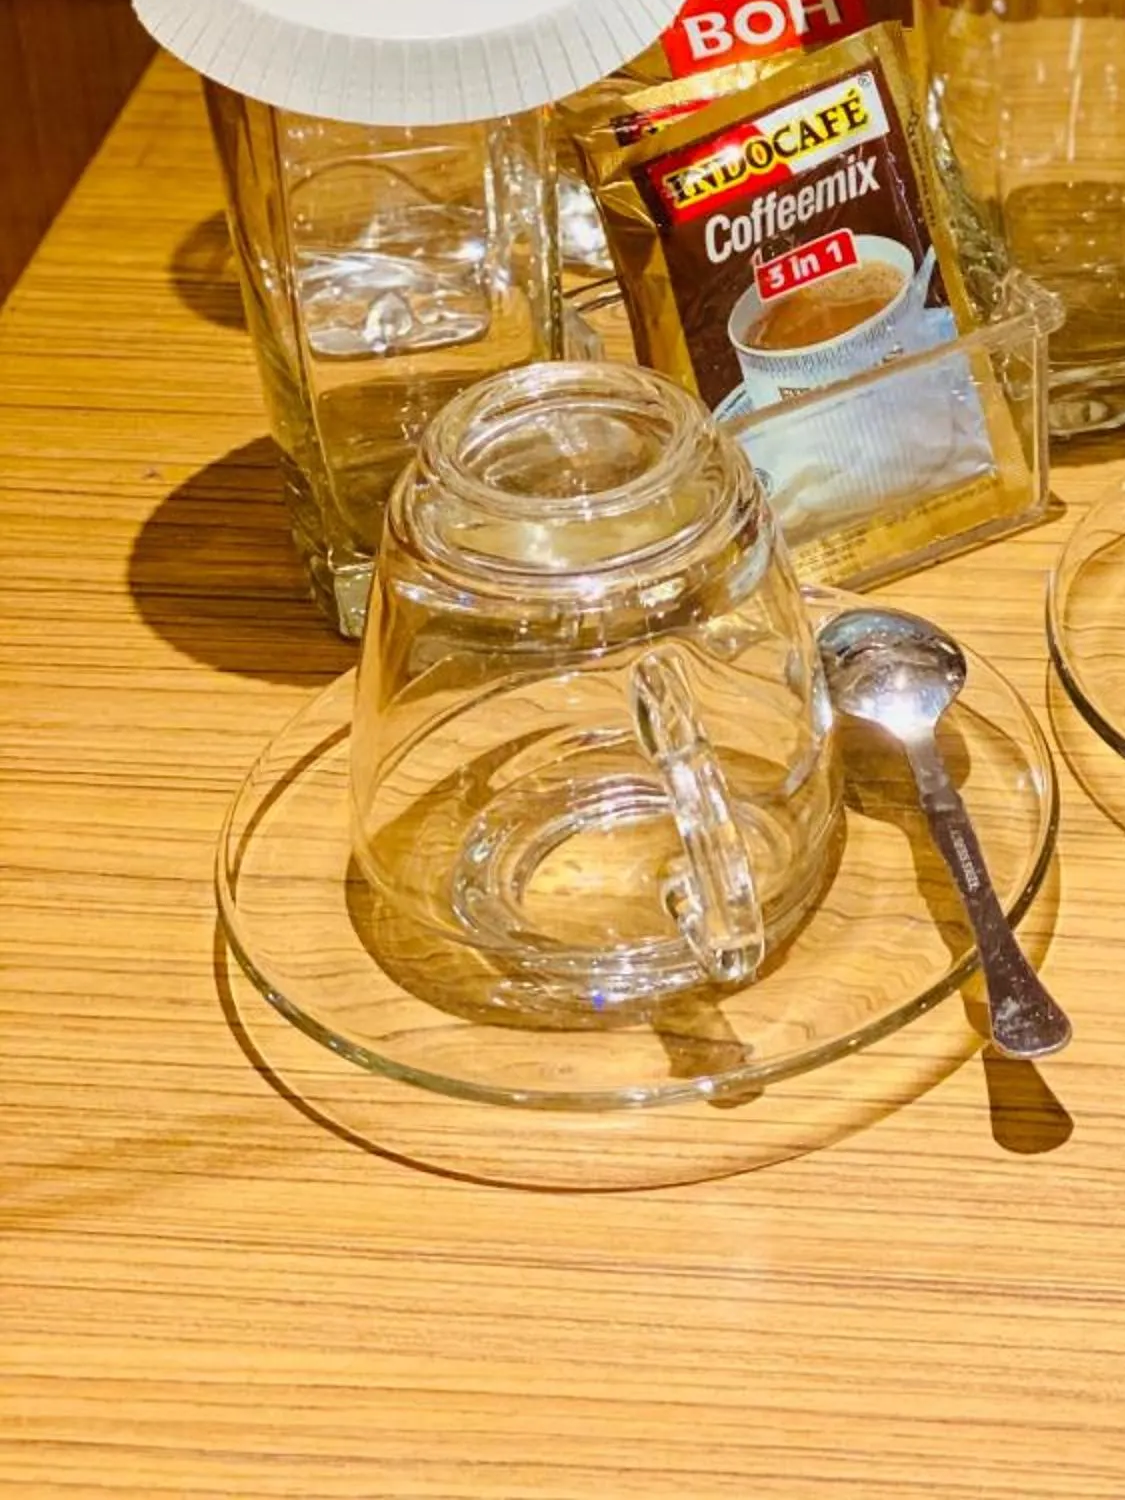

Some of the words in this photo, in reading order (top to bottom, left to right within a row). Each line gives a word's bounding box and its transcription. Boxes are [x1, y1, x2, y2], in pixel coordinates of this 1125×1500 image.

[664, 88, 870, 206] INDOCAFÉ
[704, 154, 881, 265] Coffeemix
[767, 262, 786, 290] 3
[825, 239, 844, 264] 1
